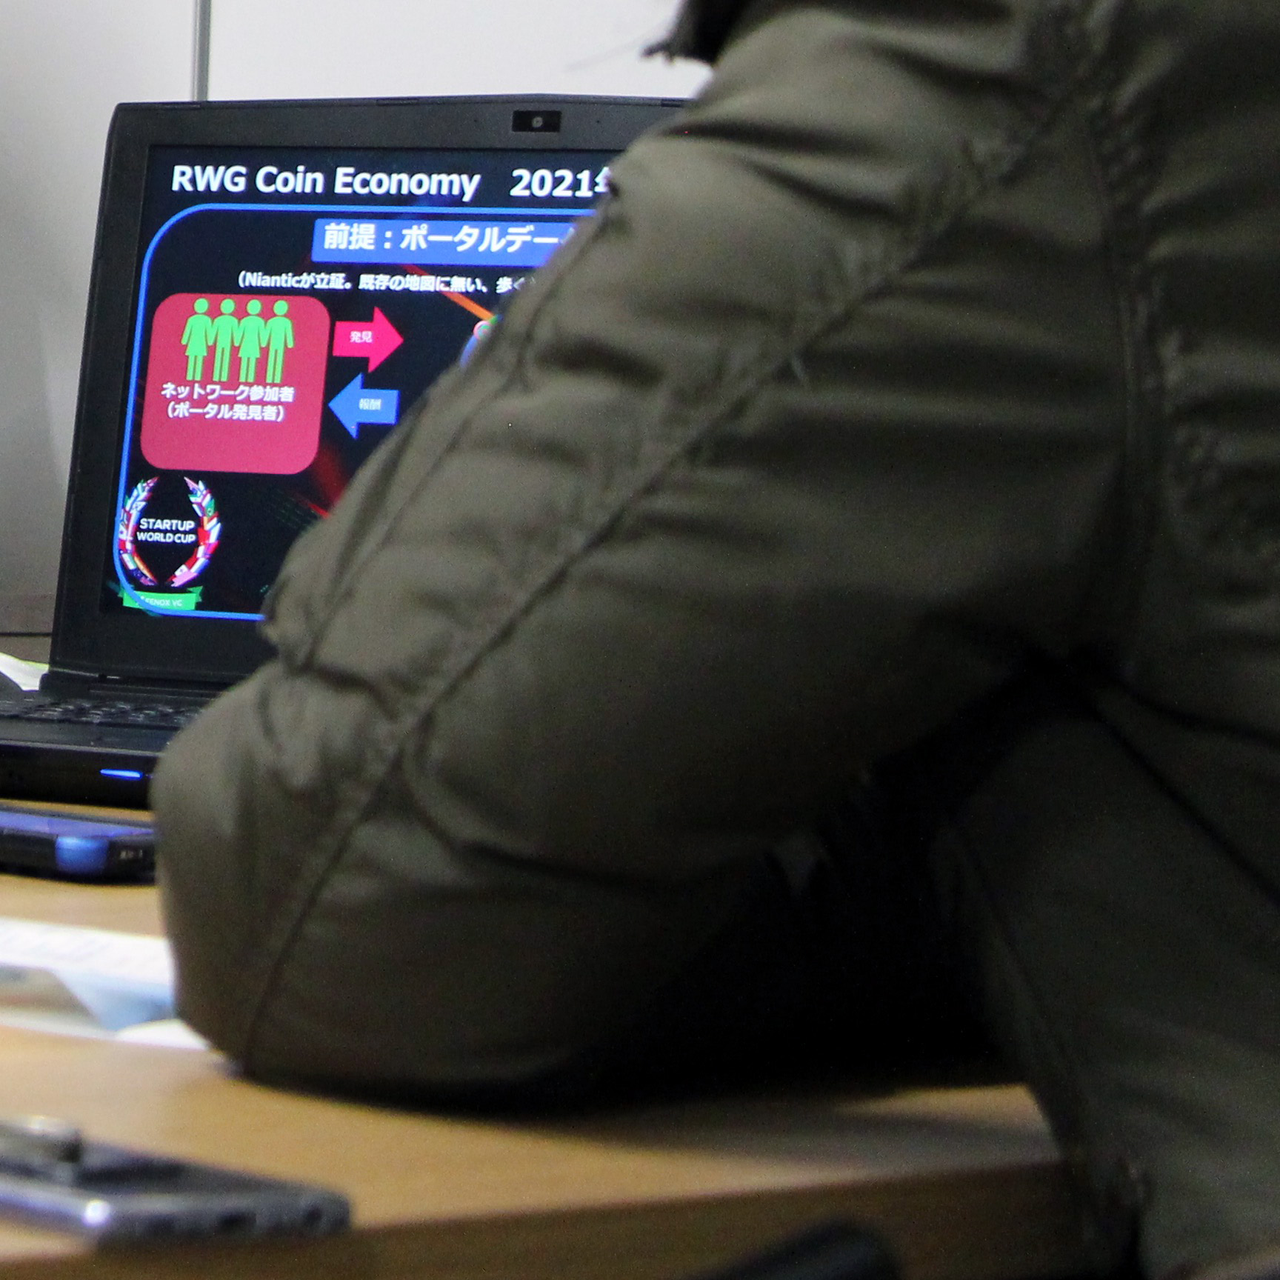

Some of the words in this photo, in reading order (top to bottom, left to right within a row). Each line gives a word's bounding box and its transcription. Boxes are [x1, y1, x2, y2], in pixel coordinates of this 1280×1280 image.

[171, 165, 246, 193] RWG
[255, 165, 324, 194] Coin
[334, 167, 481, 202] Economy
[323, 223, 576, 254] 前提：ポータルデー
[350, 330, 373, 344] 発見
[160, 382, 295, 403] ネットワーク参加者
[139, 518, 196, 532] STARTUP
[136, 531, 174, 543] WORLD
[174, 532, 196, 544] CUP
